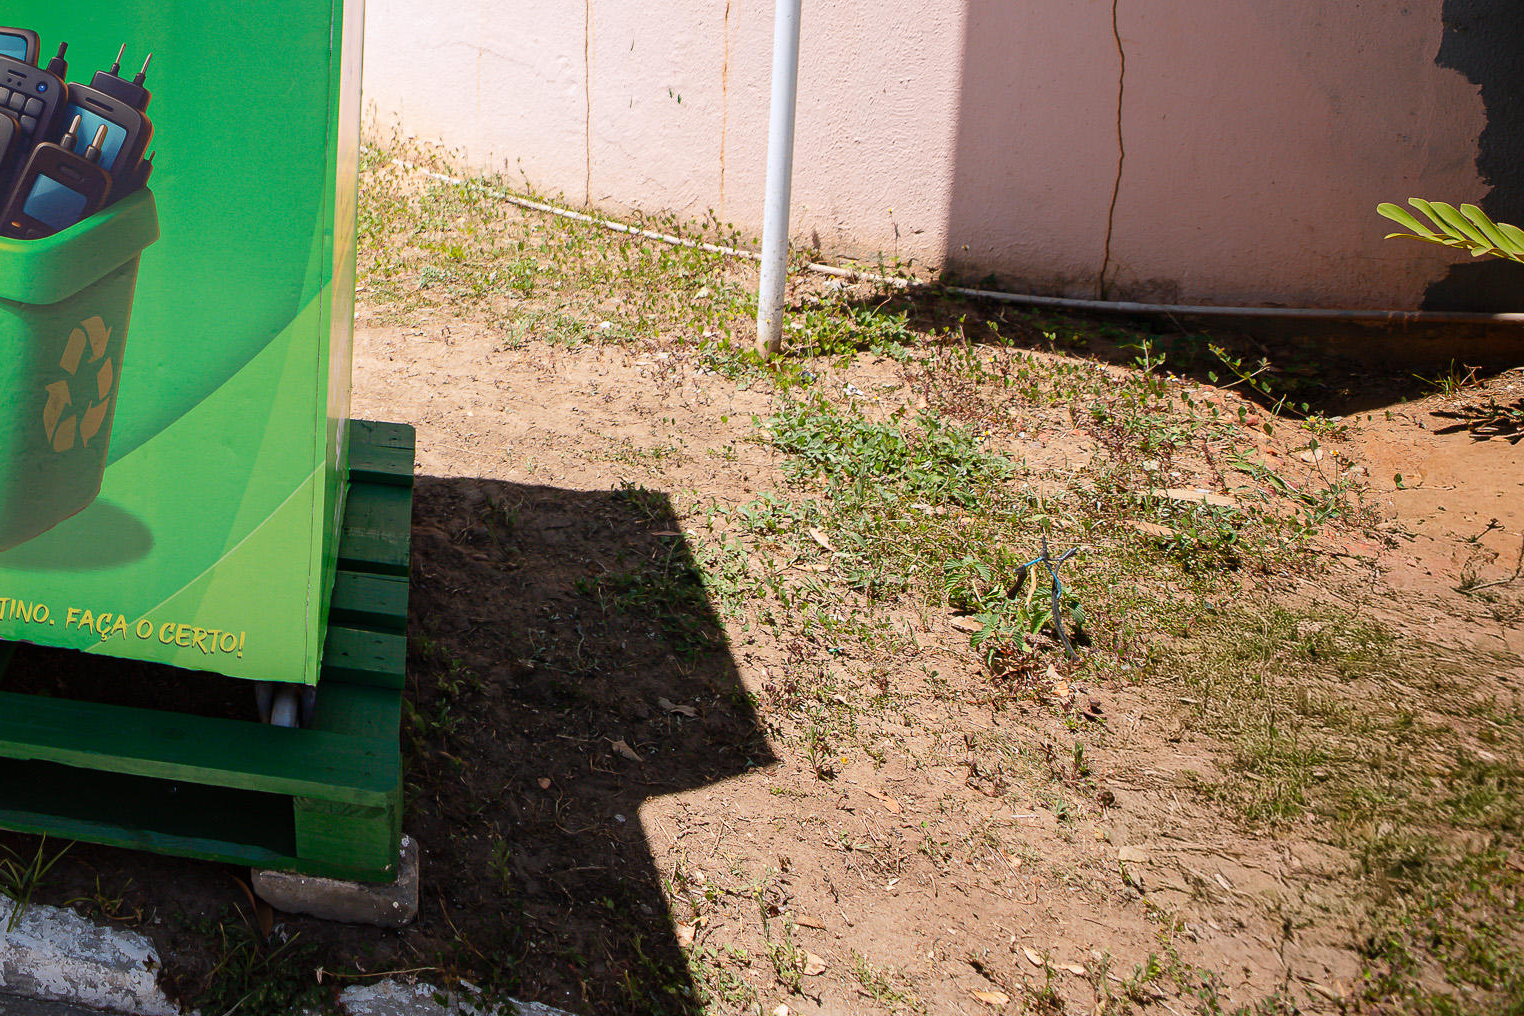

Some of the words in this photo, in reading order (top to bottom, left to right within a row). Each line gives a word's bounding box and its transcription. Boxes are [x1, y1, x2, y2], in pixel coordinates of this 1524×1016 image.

[65, 607, 128, 642] FAÇA
[136, 619, 154, 640] O
[158, 622, 246, 659] CERTO!
